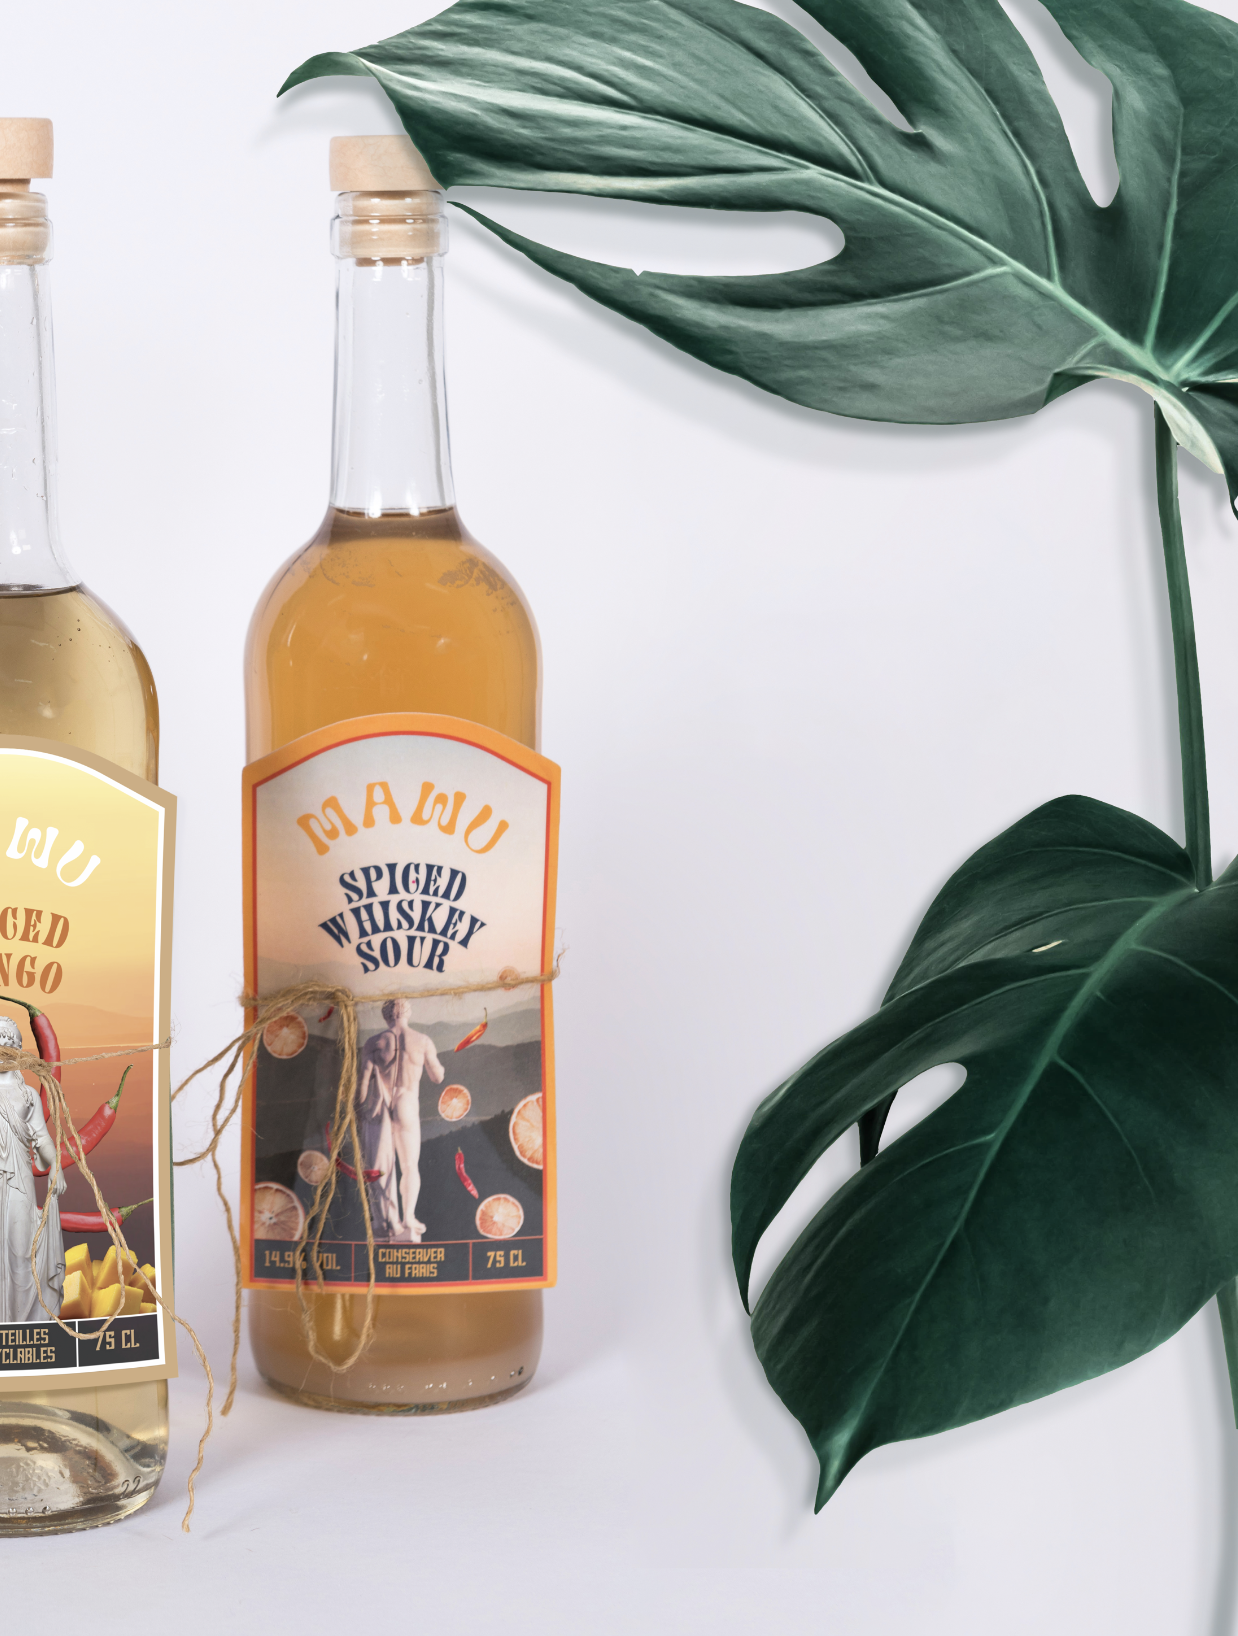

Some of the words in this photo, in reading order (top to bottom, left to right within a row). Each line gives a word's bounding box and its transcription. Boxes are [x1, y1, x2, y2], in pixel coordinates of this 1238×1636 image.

[296, 781, 510, 856] MAWU
[338, 862, 467, 905] SPICED
[317, 899, 487, 950] WHISKEY
[356, 934, 450, 974] SOUR
[264, 1250, 307, 1270] 14.9%
[378, 1248, 445, 1263] CONSERVER
[487, 1251, 505, 1268] 75
[509, 1249, 526, 1267] CL
[385, 1263, 401, 1278] AU
[404, 1263, 438, 1278] FRAIS
[95, 1331, 115, 1351] 75
[121, 1329, 140, 1348] CL
